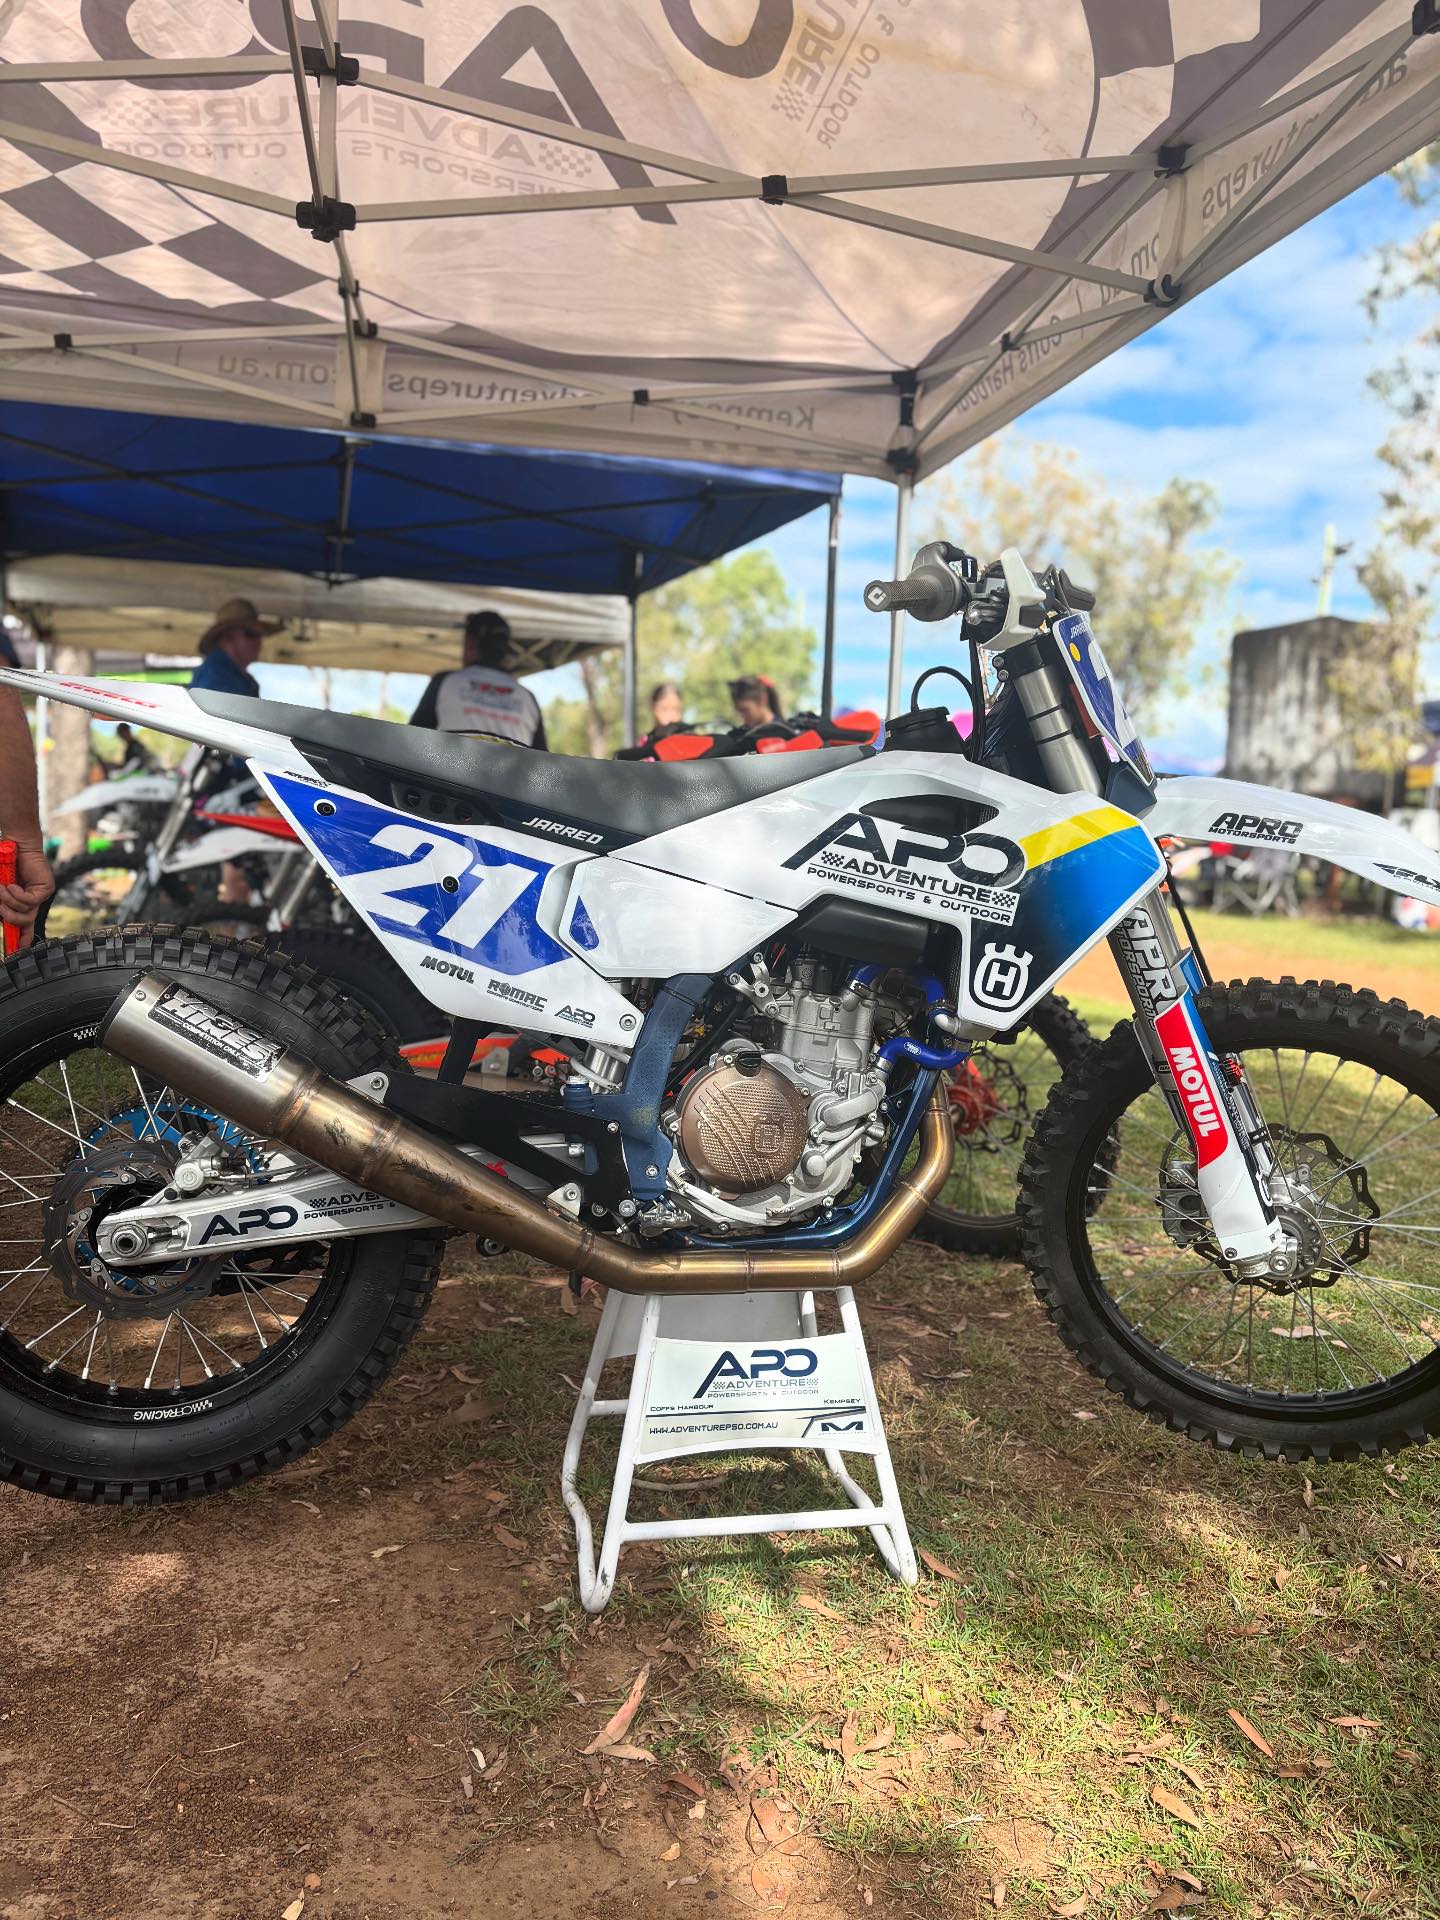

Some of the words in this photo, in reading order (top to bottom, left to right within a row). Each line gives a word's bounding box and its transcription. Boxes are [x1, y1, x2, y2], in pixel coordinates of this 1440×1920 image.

[521, 817, 604, 845] JARRED
[1208, 826, 1297, 845] MOTORSPORTS
[1211, 812, 1304, 839] APRO
[780, 812, 1026, 890] APO
[338, 824, 540, 949] 21
[807, 866, 916, 901] POWERSPORTS
[922, 895, 932, 905] &
[940, 899, 1011, 924] OUTDOOR
[842, 858, 992, 904] ADVENTURE
[420, 956, 475, 985] MOTUL
[1169, 1046, 1221, 1137] MOTUL
[198, 1205, 299, 1246] APO
[303, 1203, 384, 1220] POWERSPORTS
[693, 1348, 819, 1400] APO
[726, 1378, 806, 1390] ADVENTURE
[649, 1421, 779, 1435] WWW.ADVENTUREPSO.COM.AU
